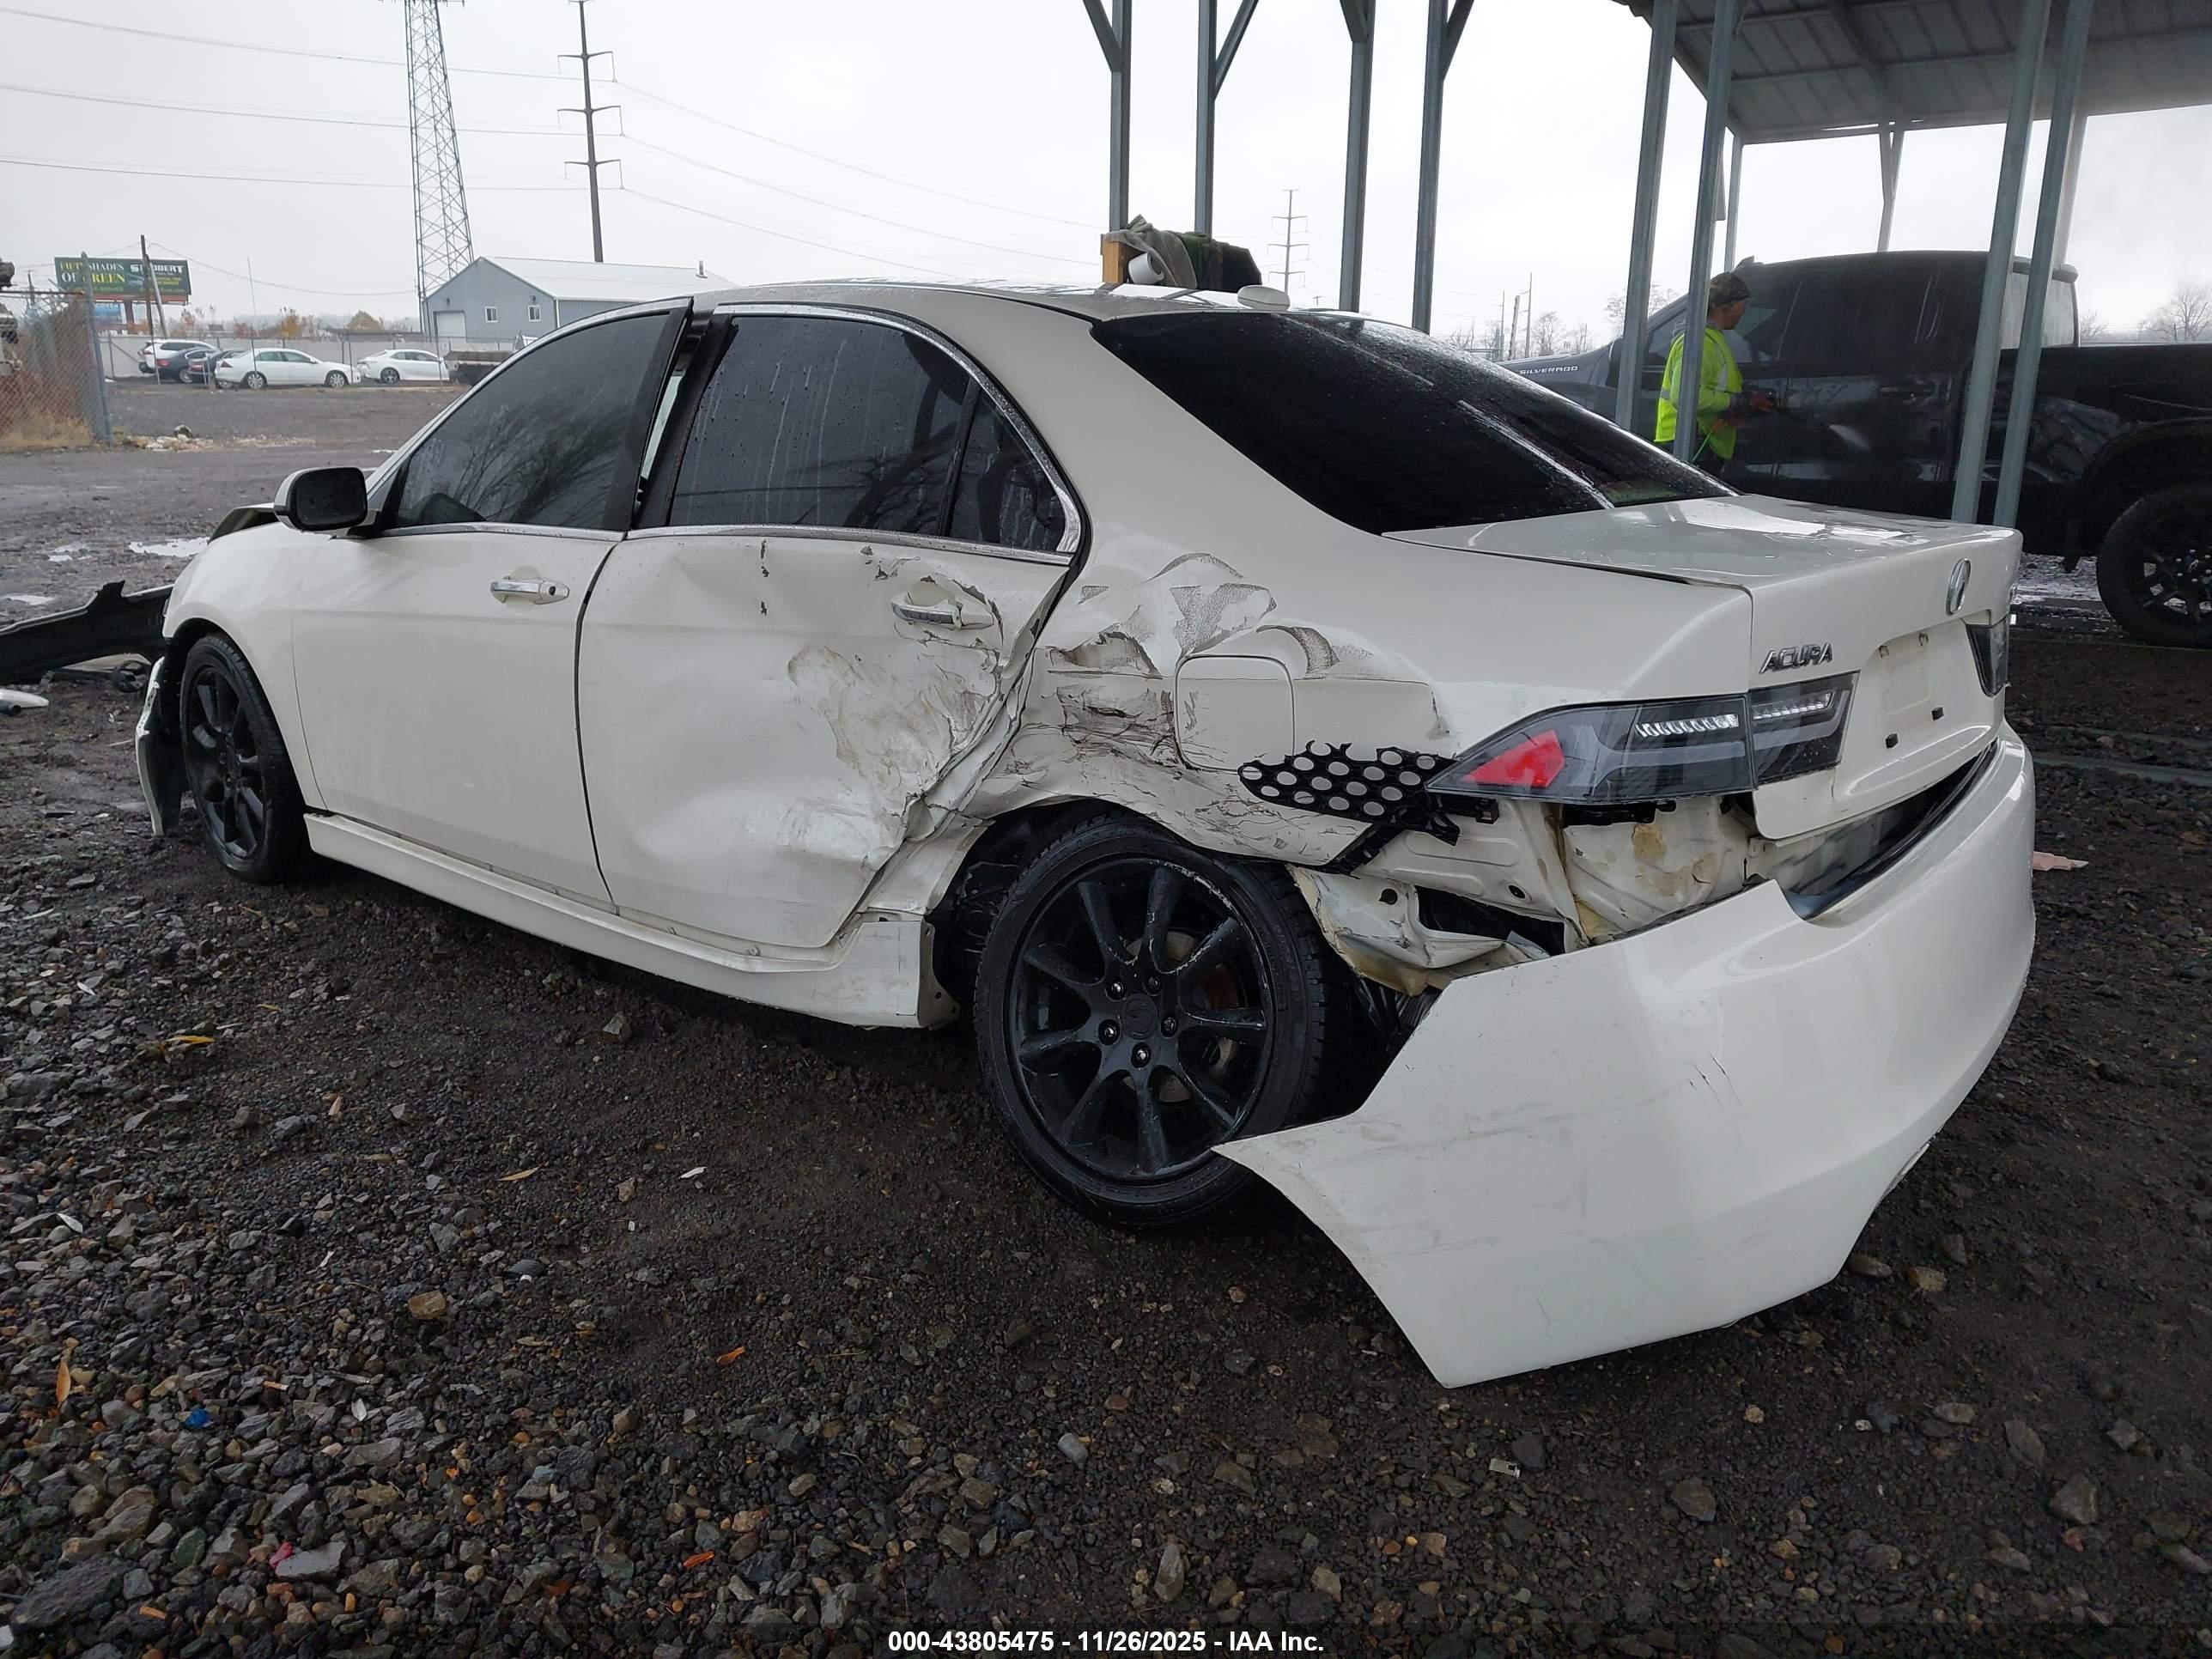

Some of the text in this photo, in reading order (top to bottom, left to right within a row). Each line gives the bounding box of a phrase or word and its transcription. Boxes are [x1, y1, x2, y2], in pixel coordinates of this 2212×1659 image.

[60, 261, 83, 270] FIFT
[130, 264, 185, 273] STOBERT
[61, 271, 77, 283] OF
[1519, 366, 1578, 374] SILVERADO
[1759, 642, 1832, 674] ACURA
